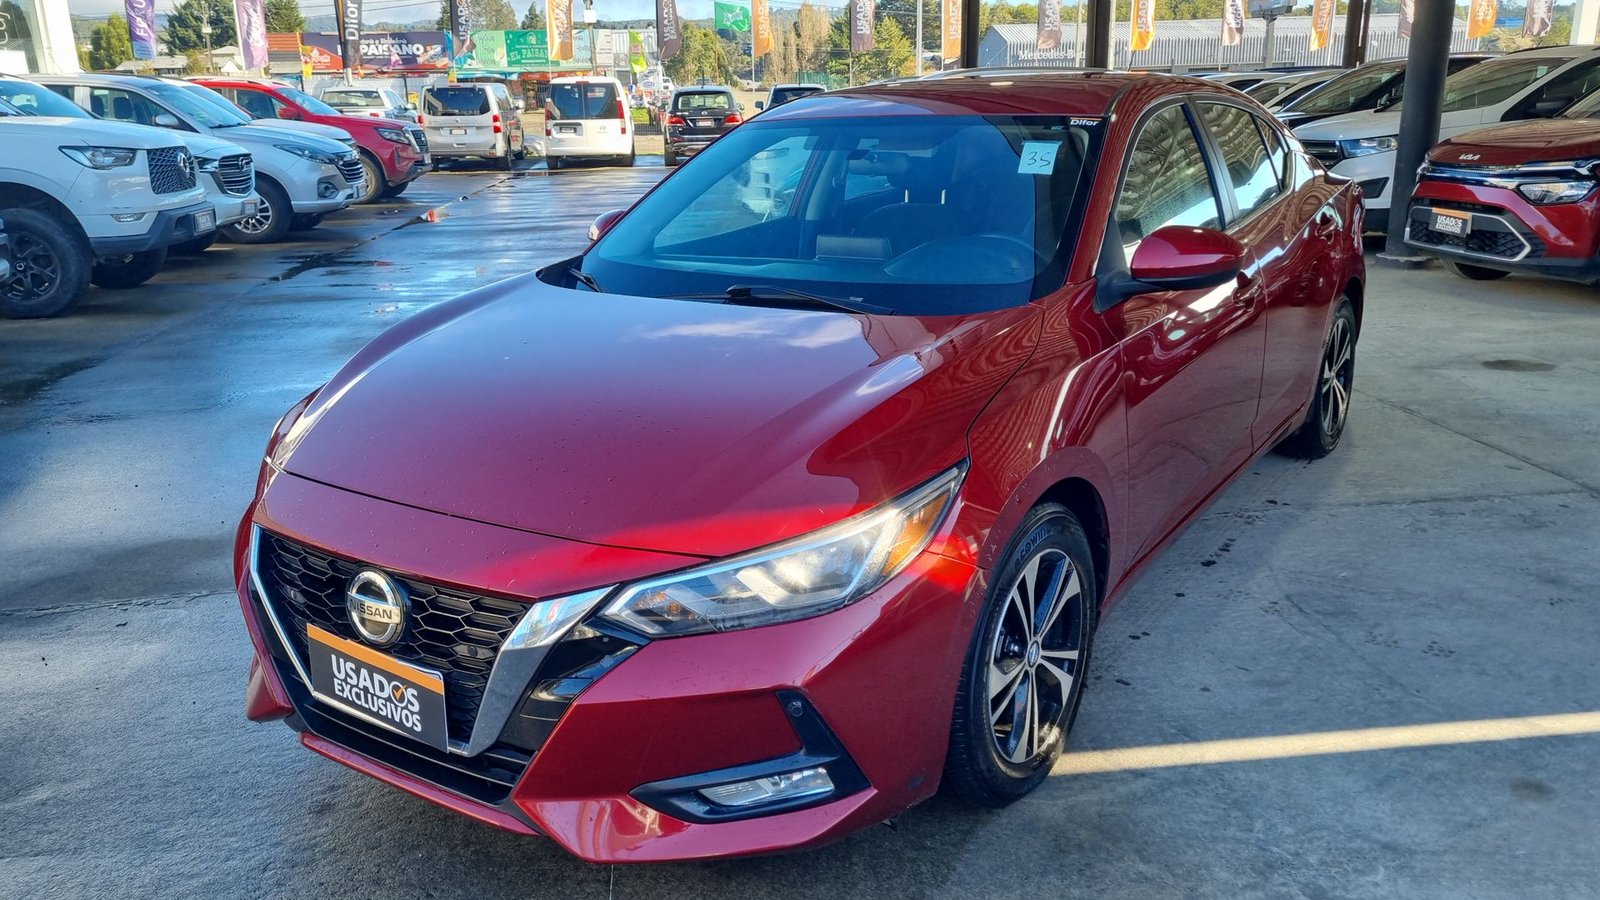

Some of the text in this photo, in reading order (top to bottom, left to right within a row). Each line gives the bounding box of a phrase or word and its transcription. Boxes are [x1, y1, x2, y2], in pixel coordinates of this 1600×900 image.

[345, 0, 360, 40] Difor
[1018, 49, 1086, 60] Mercedes-Bn
[1437, 215, 1463, 227] USADOS
[350, 601, 393, 620] NISSAN
[331, 654, 421, 714] USADOS
[333, 678, 422, 732] EXCLUSIVOS
